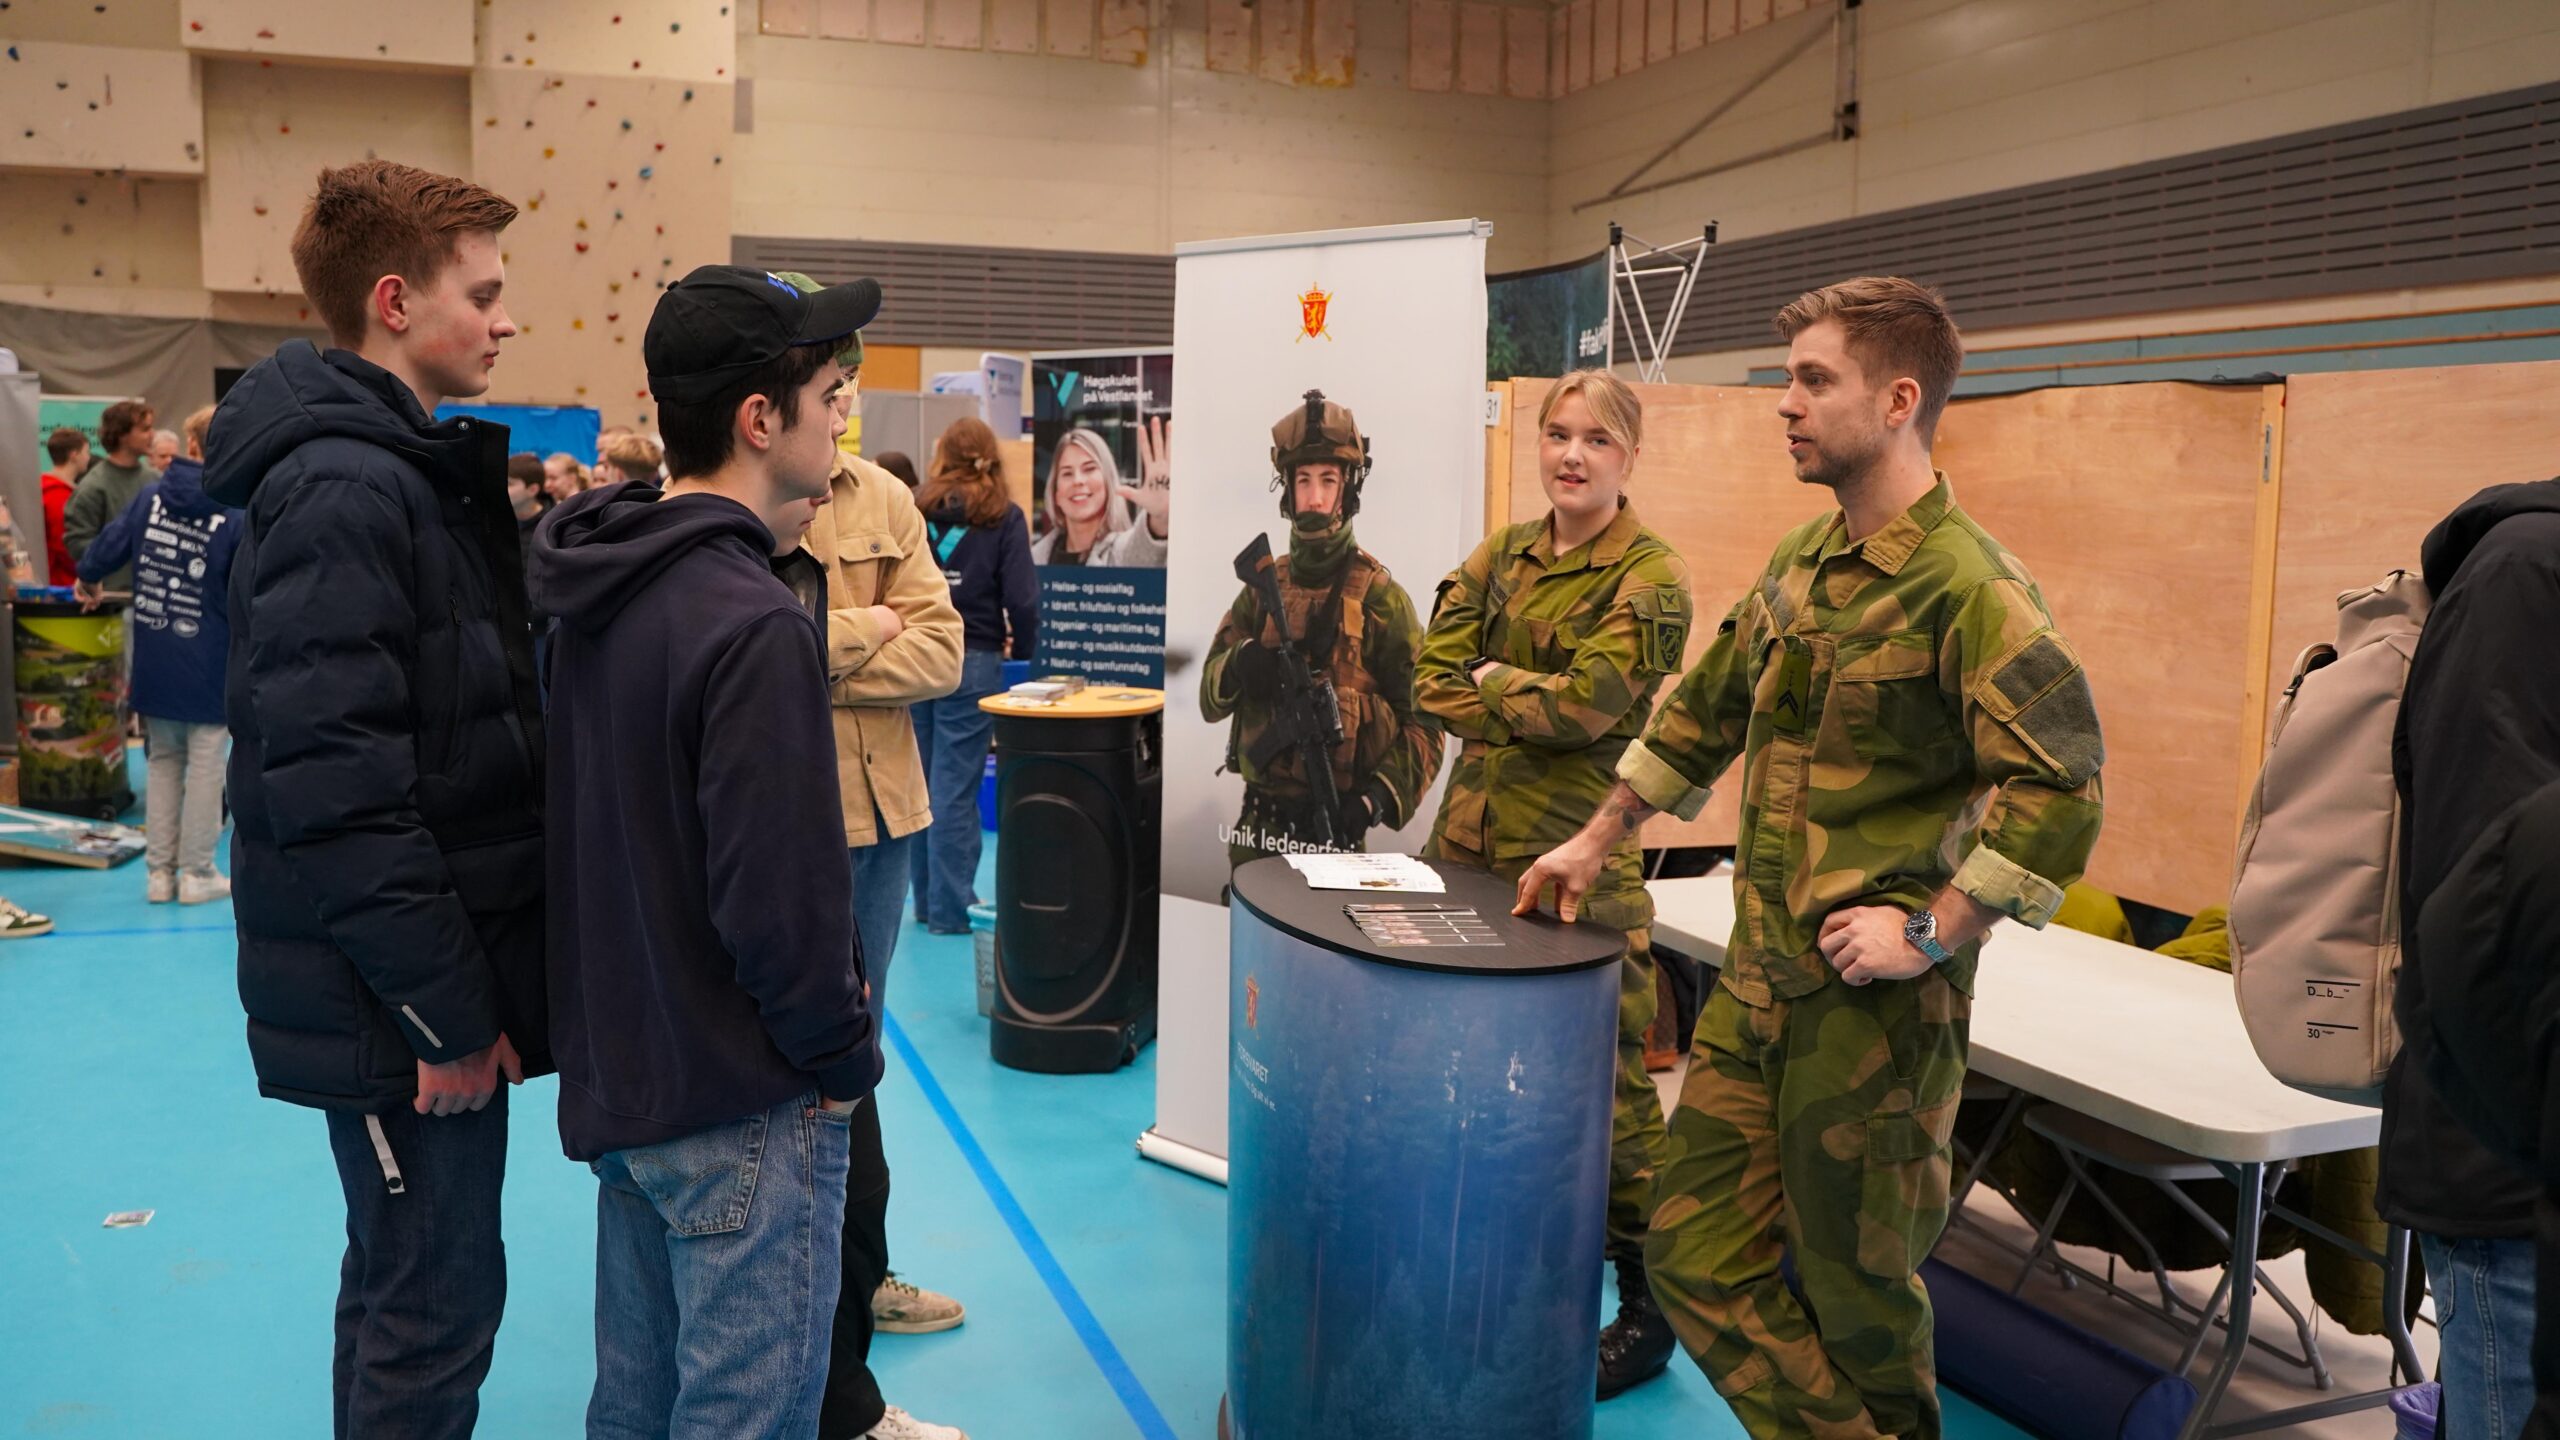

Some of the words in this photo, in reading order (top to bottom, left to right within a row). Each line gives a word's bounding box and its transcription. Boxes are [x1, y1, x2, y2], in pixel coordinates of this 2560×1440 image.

[1083, 375, 1140, 389] Høgskulen
[1083, 391, 1098, 405] på
[1051, 581, 1080, 592] Helse-
[1082, 583, 1094, 595] og
[1095, 583, 1135, 597] sosialfag
[1051, 601, 1078, 612] Idrett,
[1079, 601, 1116, 613] friluftsliv
[1117, 604, 1130, 616] og
[1050, 620, 1091, 632] Ingeniør-
[1091, 623, 1103, 634] og
[1104, 622, 1143, 633] maritime
[1144, 624, 1160, 637] fag
[1082, 641, 1094, 653] og
[1050, 657, 1079, 669] Natur-
[1080, 661, 1092, 672] og
[1093, 660, 1150, 676] samfunnsfag
[1218, 823, 1256, 848] Unik
[2307, 1028, 2320, 1039] 30
